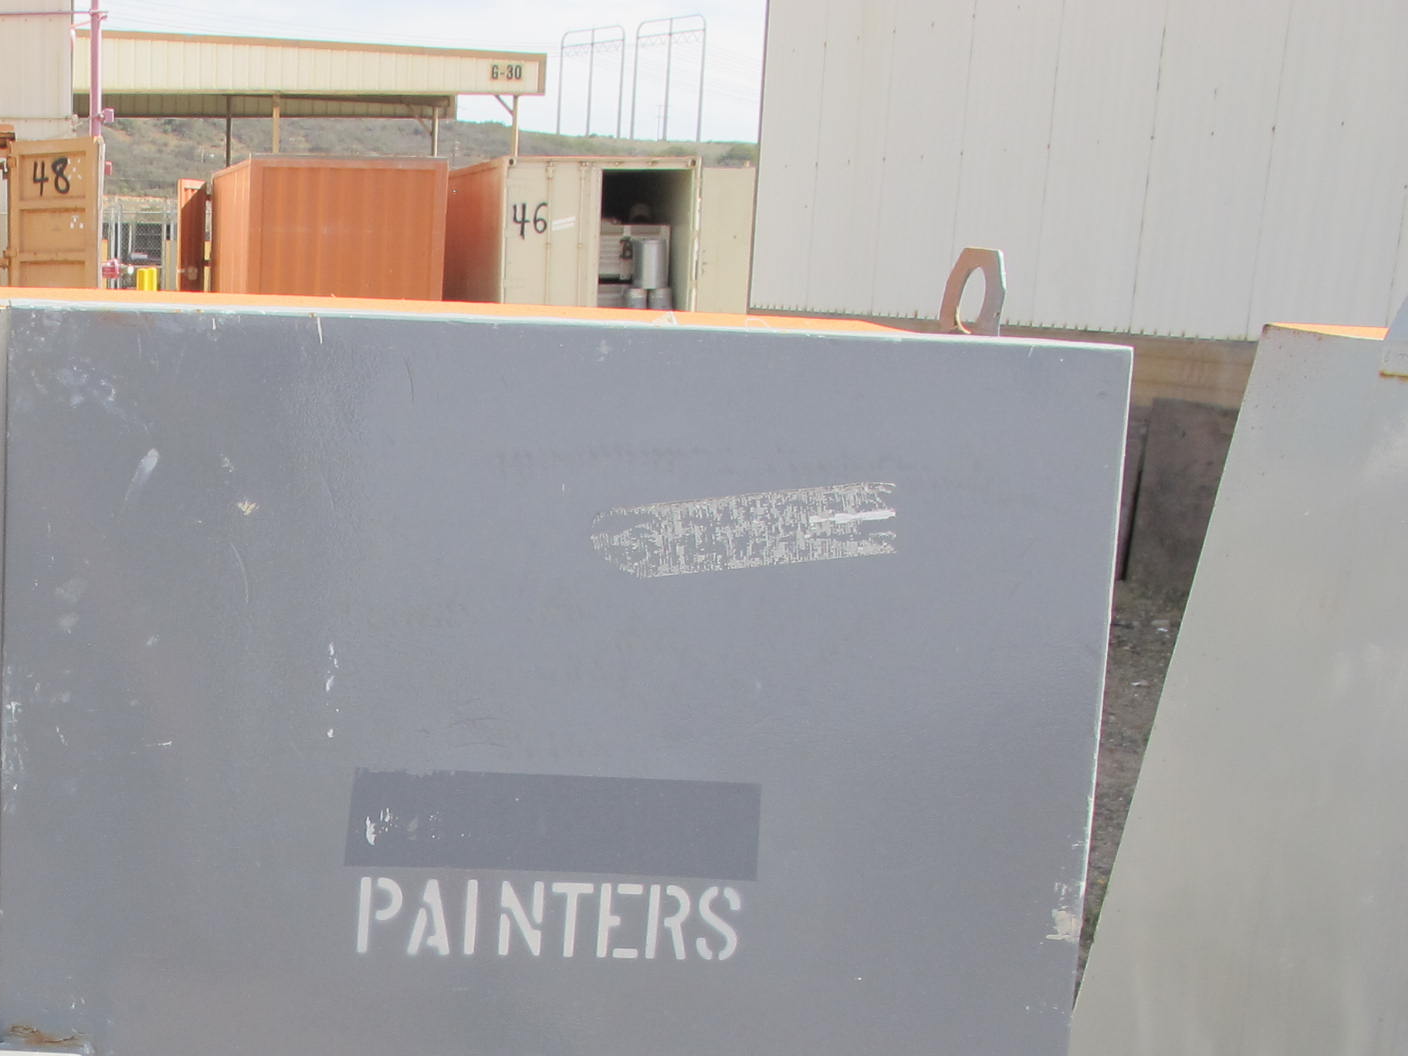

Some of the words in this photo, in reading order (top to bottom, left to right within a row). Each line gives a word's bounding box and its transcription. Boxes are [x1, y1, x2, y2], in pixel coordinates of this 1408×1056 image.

[491, 64, 523, 80] G-30
[33, 157, 70, 197] 48
[512, 202, 549, 240] 46
[355, 875, 742, 962] PAINTERS
